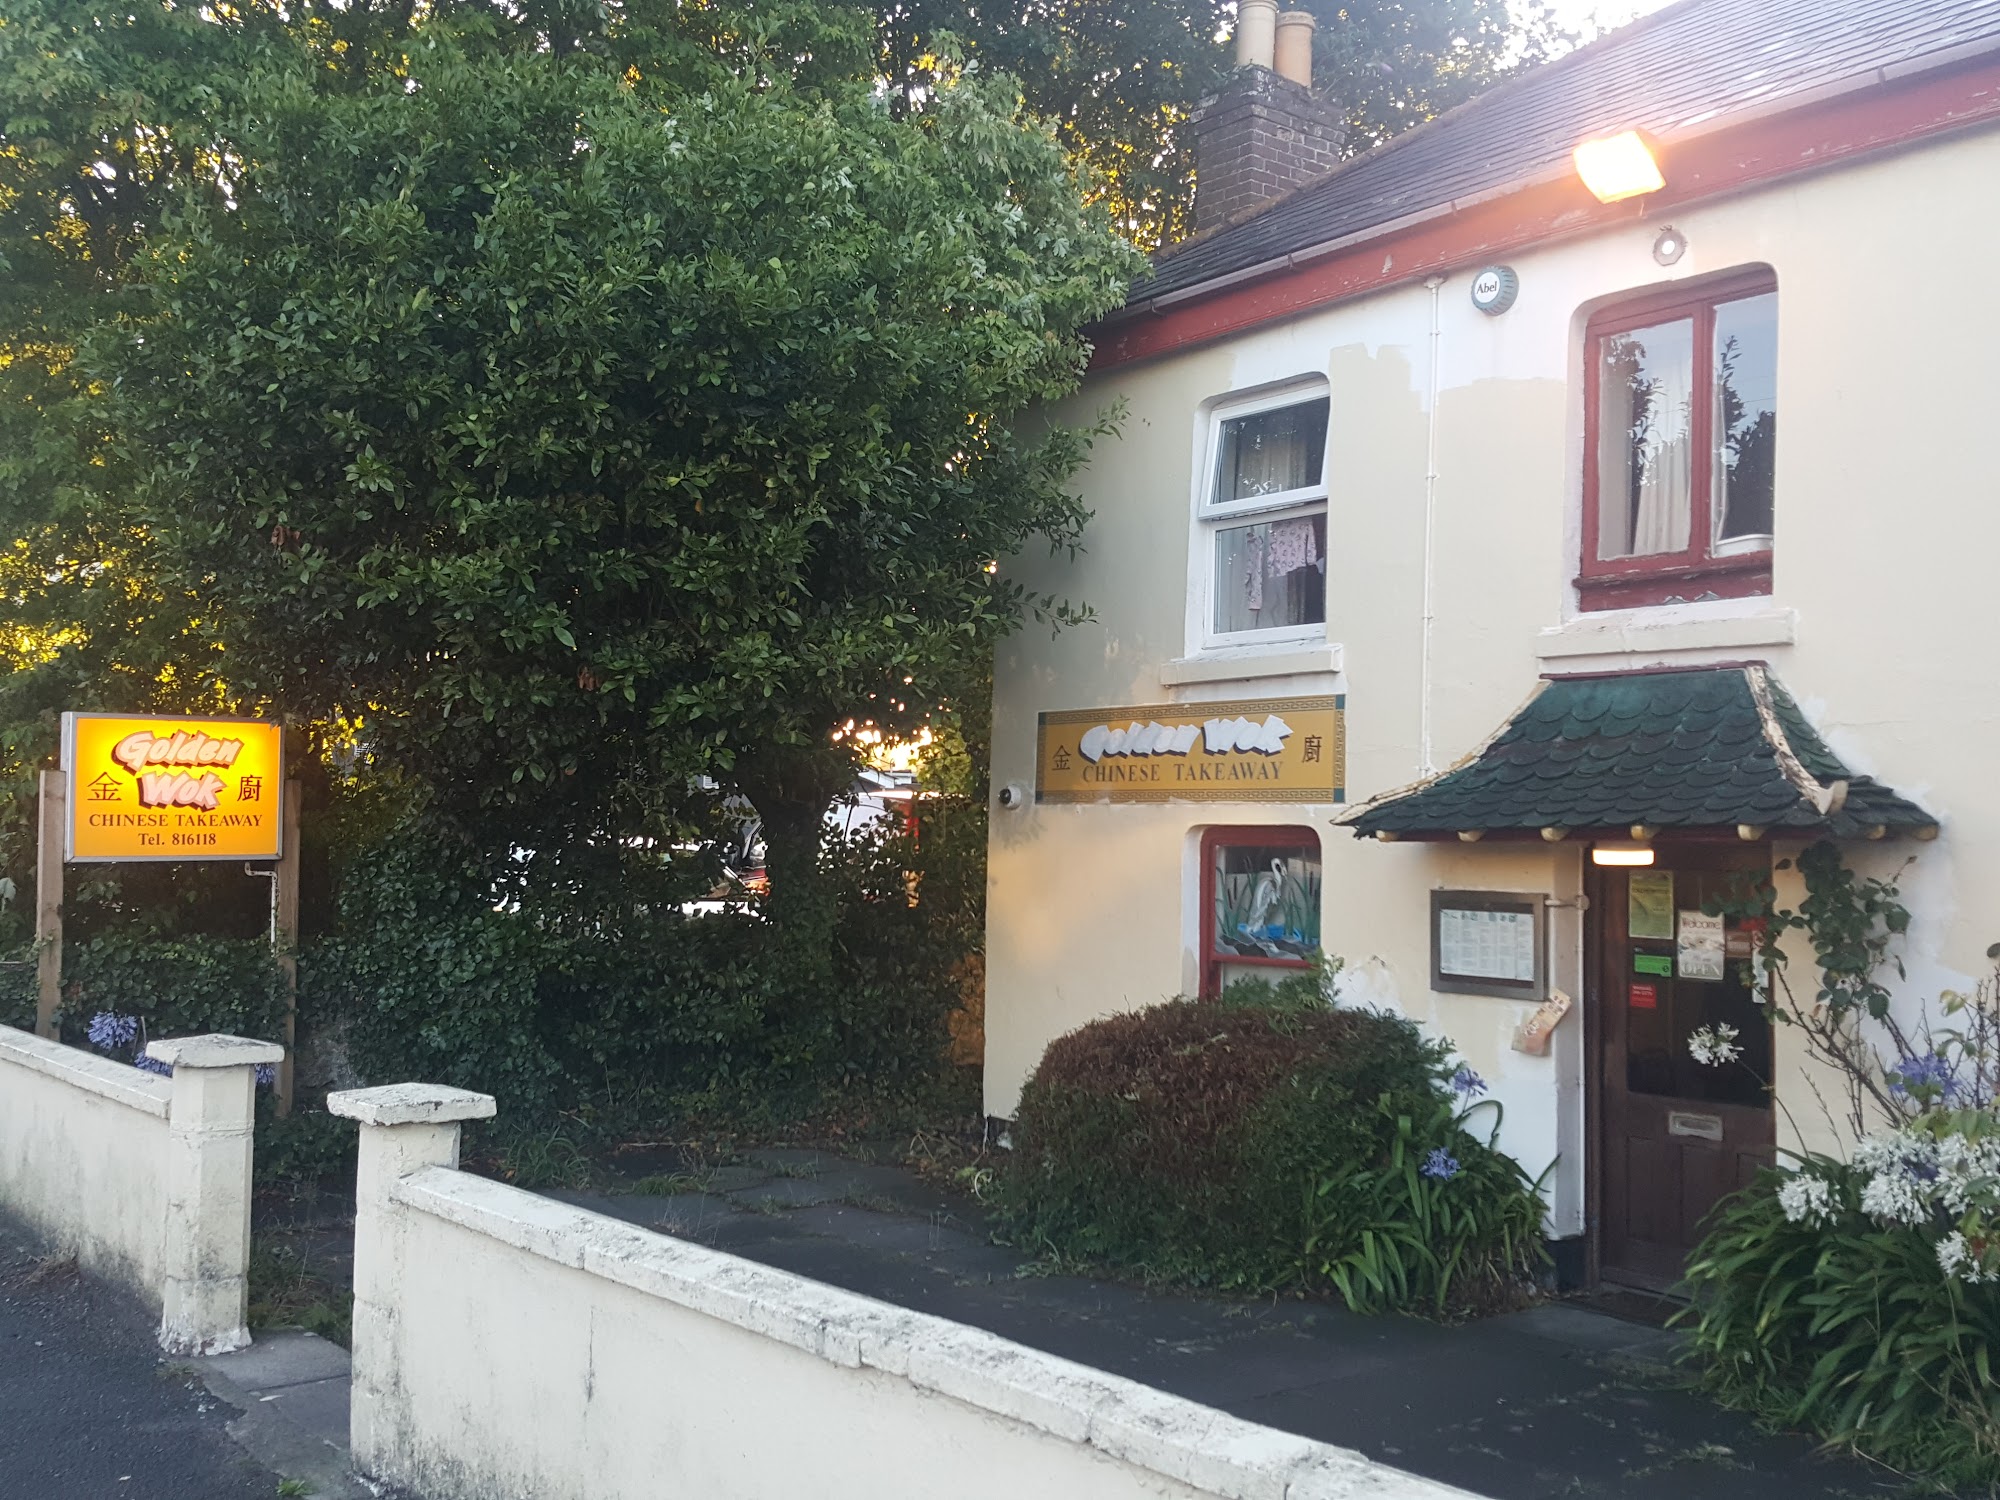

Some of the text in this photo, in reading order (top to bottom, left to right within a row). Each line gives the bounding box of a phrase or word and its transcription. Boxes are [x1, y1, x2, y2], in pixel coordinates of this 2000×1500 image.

[1476, 281, 1498, 295] Abel
[111, 729, 245, 775] Golden
[1051, 745, 1071, 771] 金
[1082, 761, 1283, 783] CHINESE TAKEAWAY
[87, 771, 123, 801] 金
[138, 770, 228, 812] Wok
[89, 813, 263, 827] CHINESE TAKEAWAY
[138, 832, 216, 846] Tel. 816118
